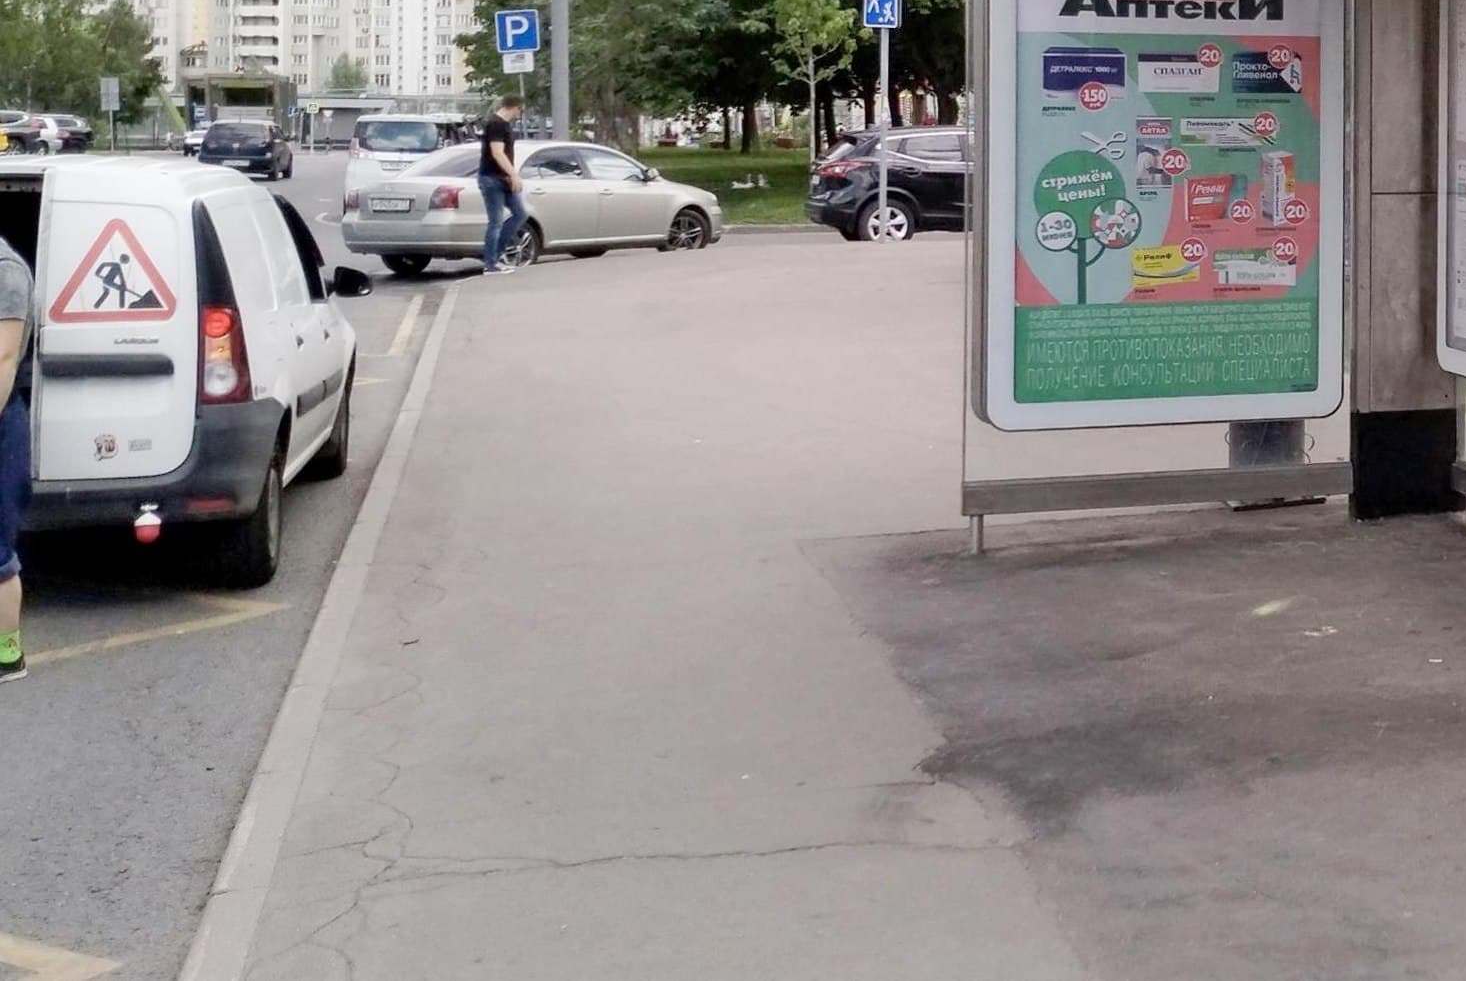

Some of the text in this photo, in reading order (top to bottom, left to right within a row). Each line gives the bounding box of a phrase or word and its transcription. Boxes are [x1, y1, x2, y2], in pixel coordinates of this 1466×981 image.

[505, 15, 529, 47] P
[1042, 169, 1113, 190] стрижём
[1057, 184, 1106, 203] цены!
[1027, 339, 1089, 364] ИМЕЮТСЯ
[1229, 331, 1311, 356] НЕОБХОДИМО
[1027, 357, 1312, 390] ПОЛУЧЕНИЕ КОНСУЛЬТАЦИИ СПЕЦИАЛИСТА
